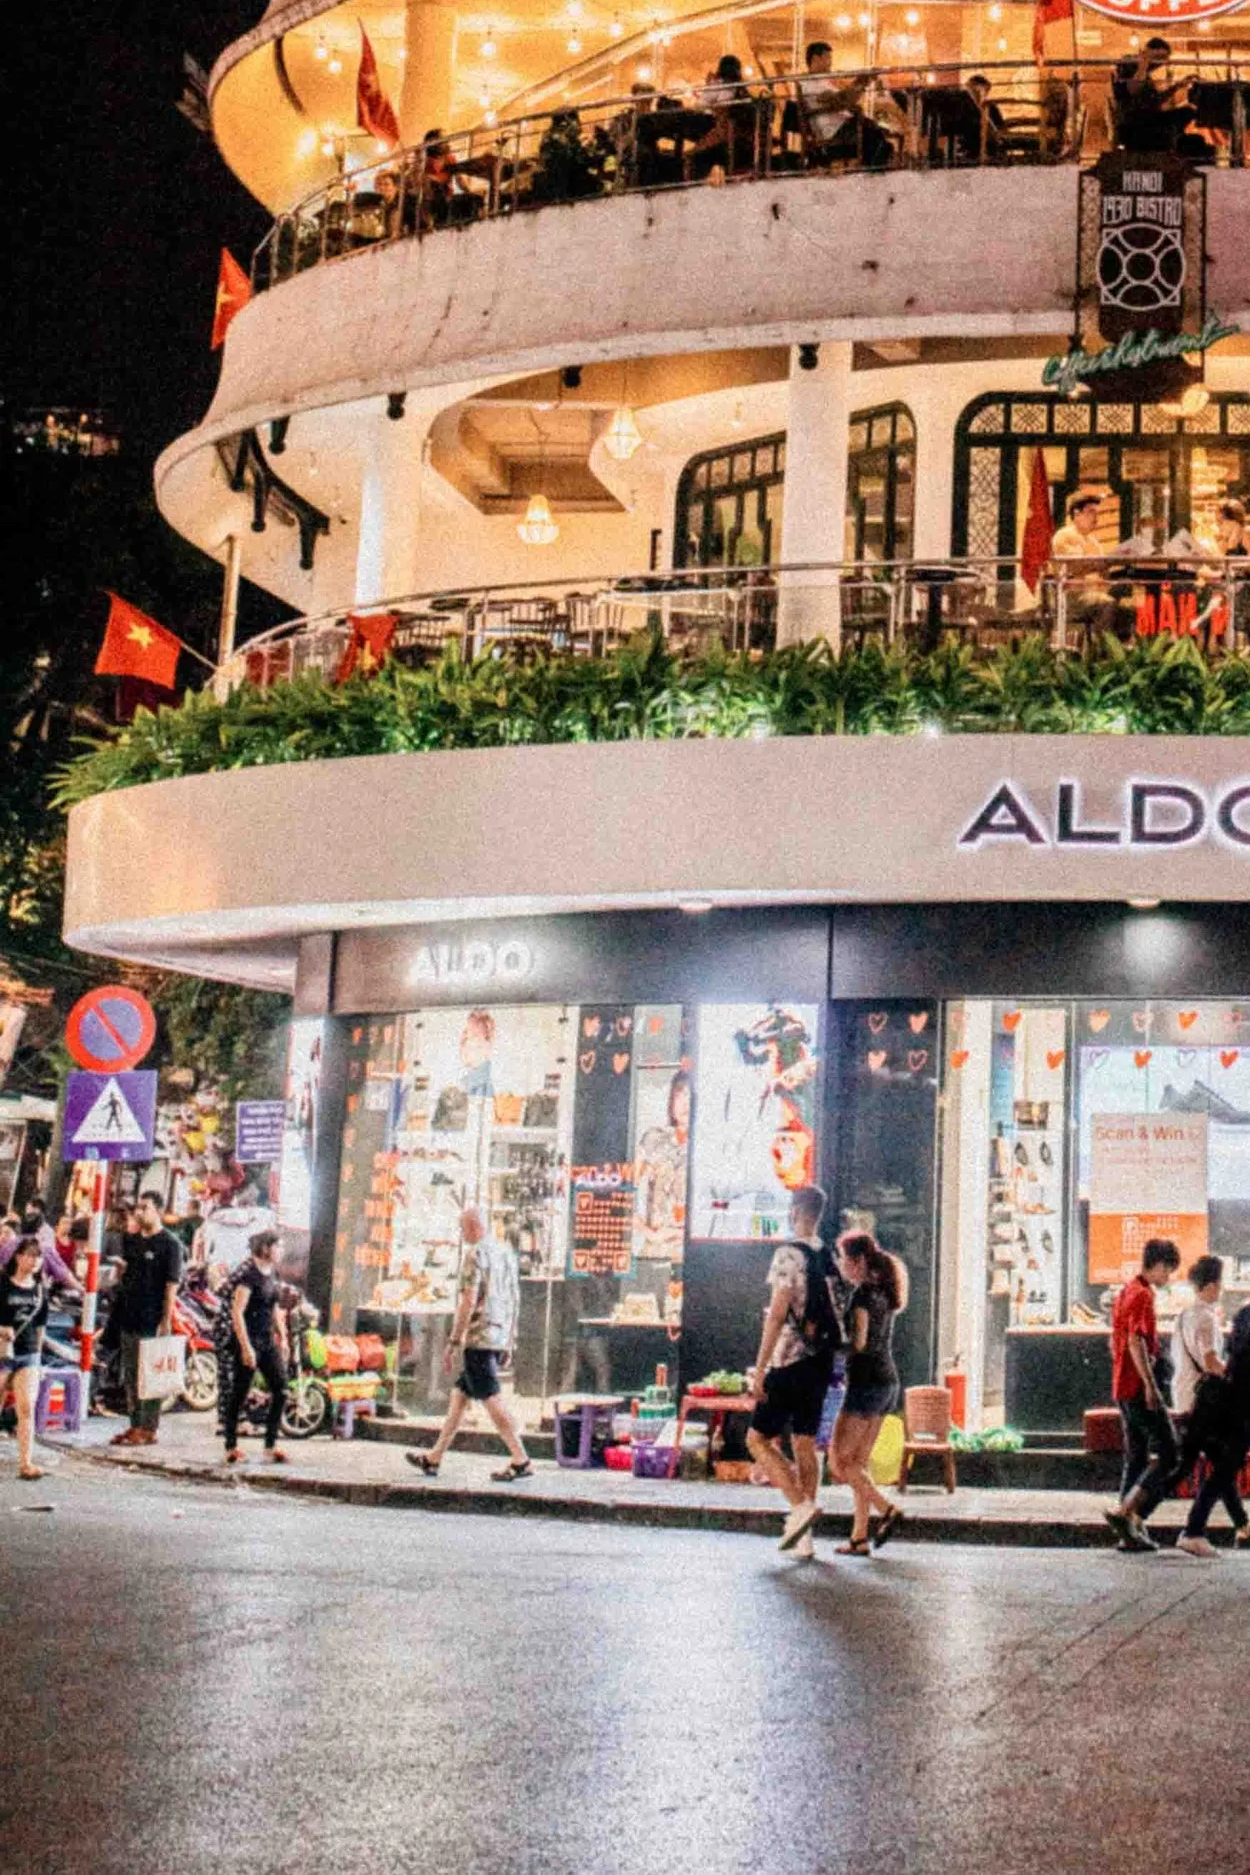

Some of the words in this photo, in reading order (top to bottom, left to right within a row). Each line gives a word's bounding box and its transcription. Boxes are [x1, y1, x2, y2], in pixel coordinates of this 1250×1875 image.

[1103, 195, 1132, 224] 1930
[1136, 195, 1182, 226] BISTRO
[405, 941, 533, 986] ALDO
[1095, 1126, 1134, 1140] Scan
[1153, 1125, 1184, 1141] Win
